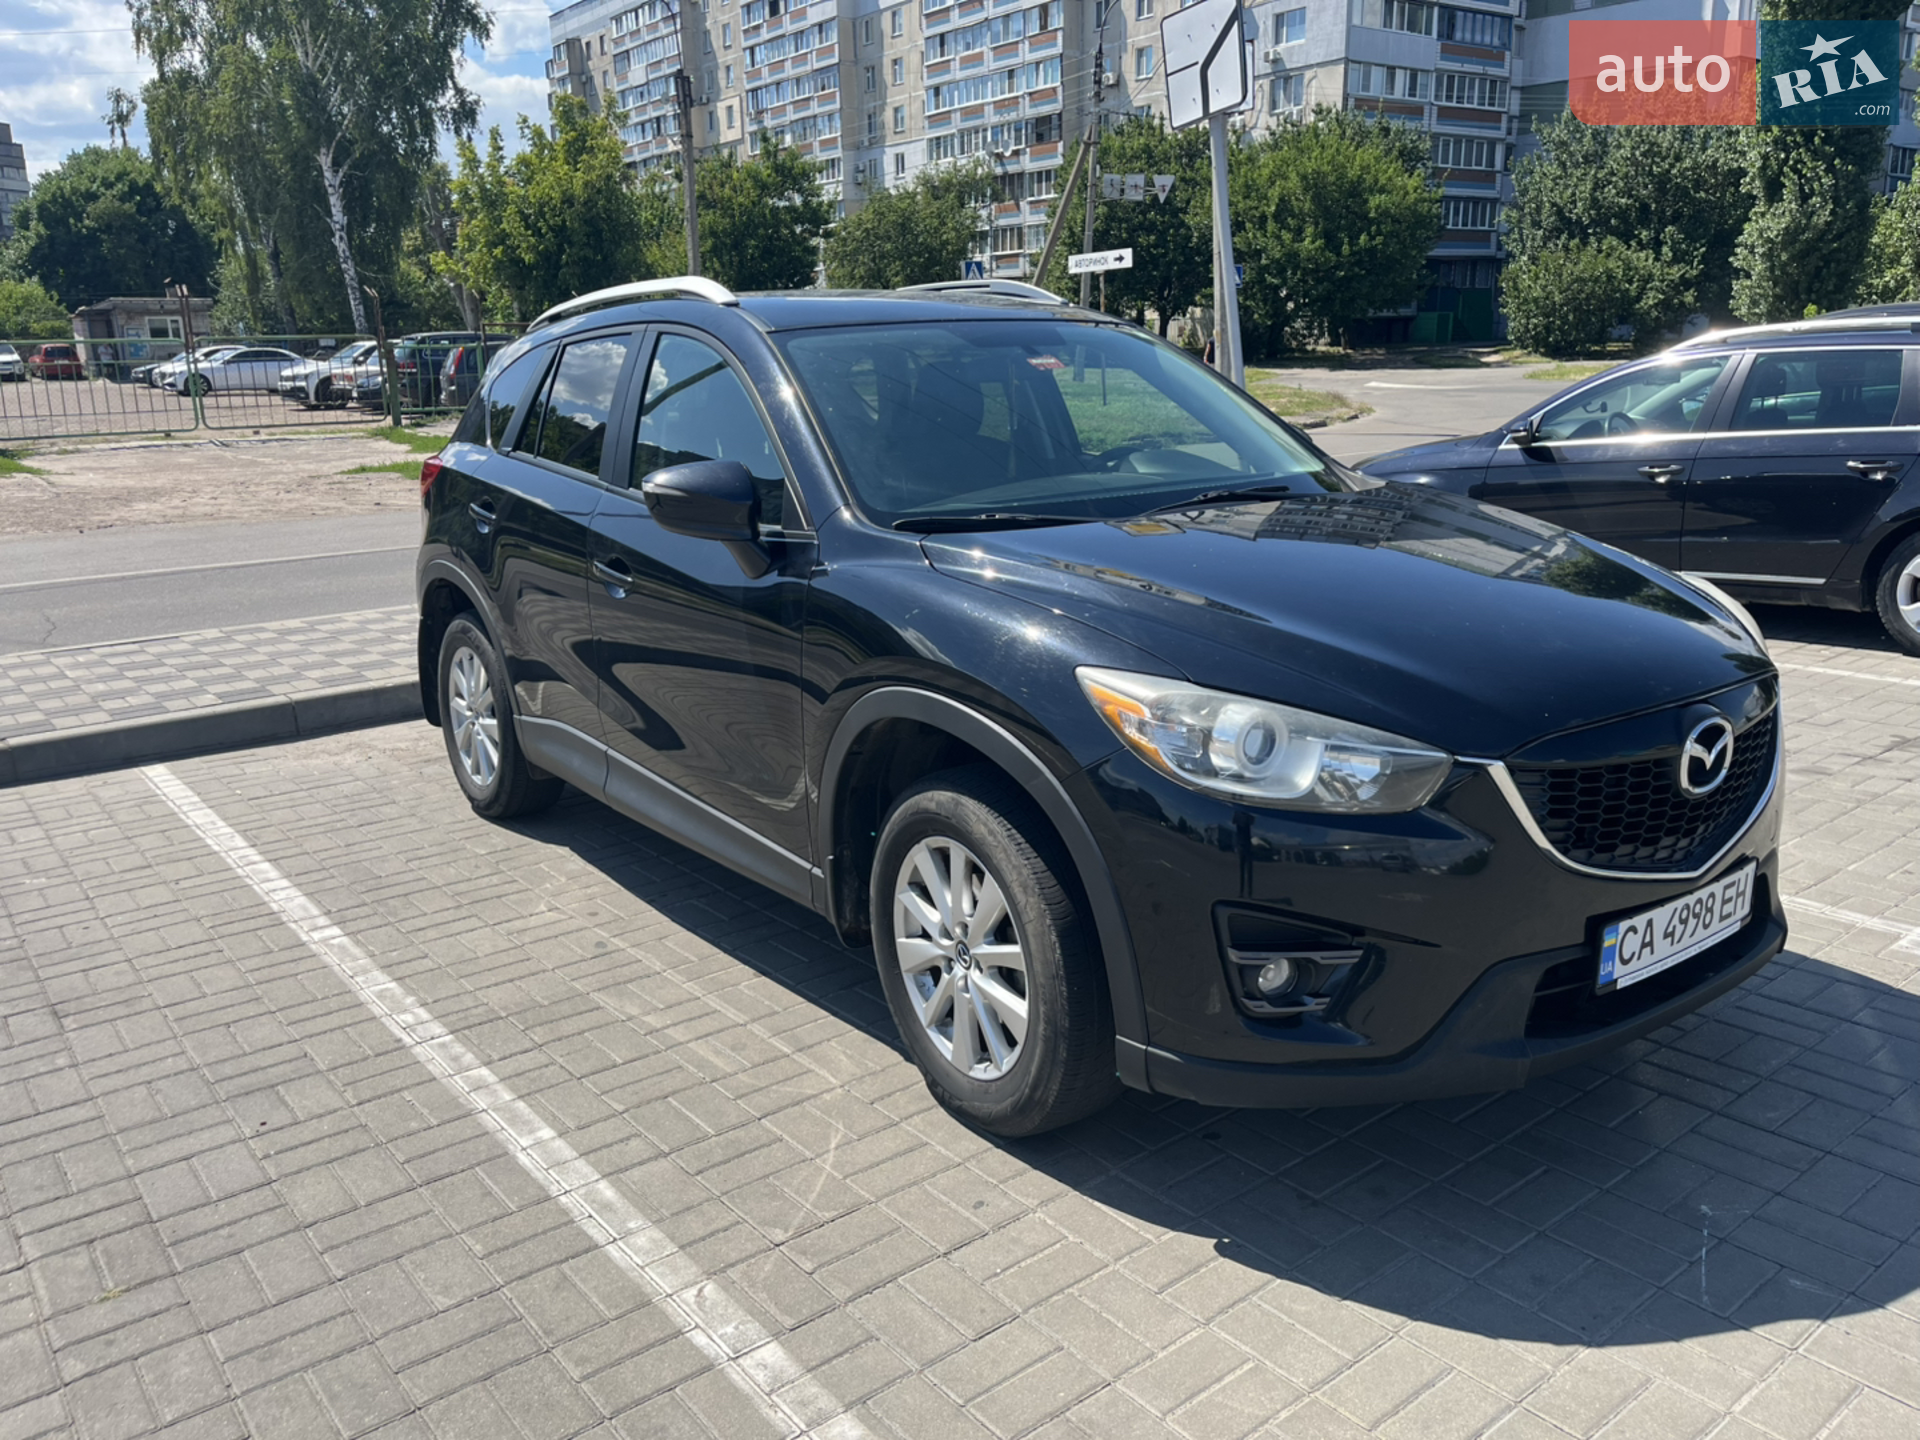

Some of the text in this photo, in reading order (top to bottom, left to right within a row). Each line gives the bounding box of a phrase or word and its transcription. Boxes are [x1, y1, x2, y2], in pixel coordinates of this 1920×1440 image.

[1074, 256, 1109, 269] АВТОРИНОК
[1618, 918, 1654, 966] CA
[1663, 891, 1716, 947] 4998
[1718, 872, 1749, 924] EH
[1600, 961, 1613, 976] UA
